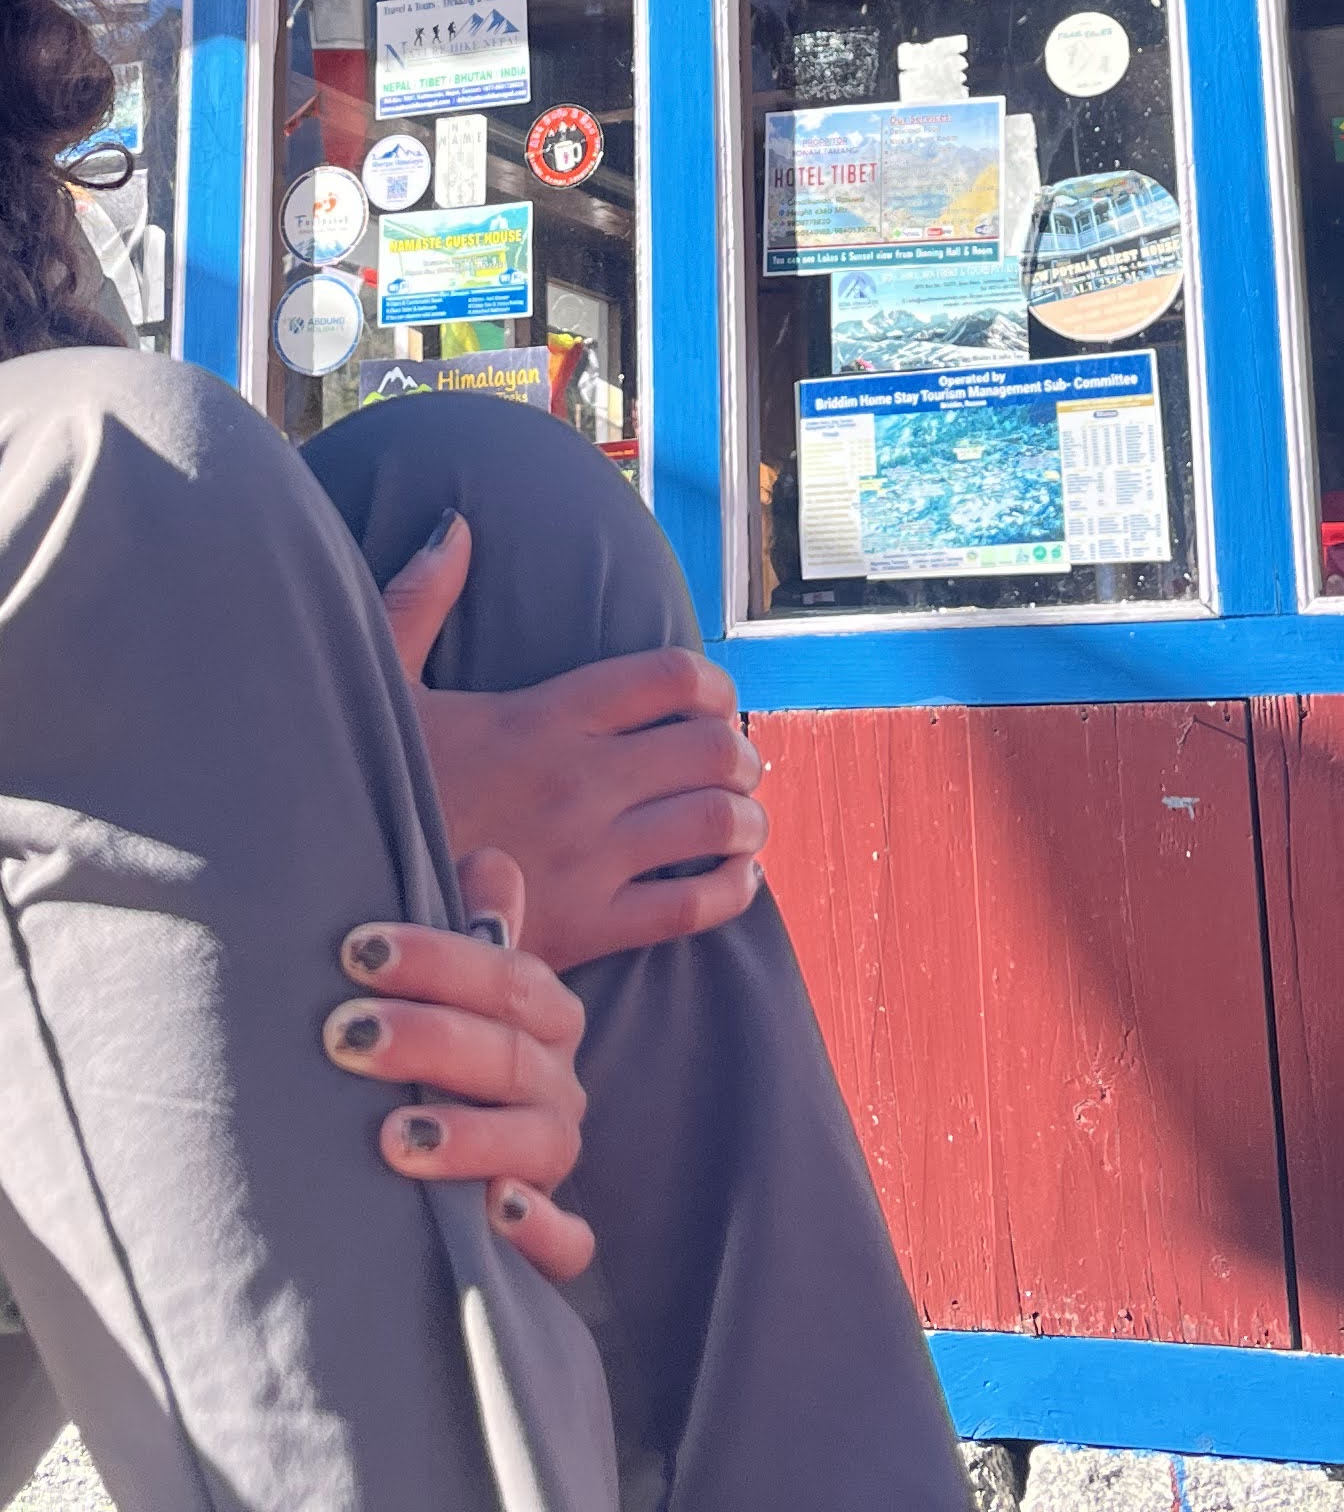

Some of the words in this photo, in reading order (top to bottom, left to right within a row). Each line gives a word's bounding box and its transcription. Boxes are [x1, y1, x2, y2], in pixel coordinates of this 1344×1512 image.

[384, 5, 405, 15] Travel
[415, 2, 435, 11] Tours
[384, 82, 411, 92] NEPAL
[419, 76, 446, 87] TIBET
[454, 71, 492, 83] BHUTAN
[501, 66, 526, 78] INDIA
[774, 166, 824, 188] HOTEL
[832, 163, 877, 184] TIBET
[389, 236, 442, 253] NAMASTE
[445, 234, 480, 247] GUEST
[485, 230, 522, 244] HOUSE
[1052, 260, 1098, 280] POTALA
[1099, 249, 1138, 269] GUEST
[438, 365, 540, 392] Himalayan
[939, 374, 989, 387] Operated
[992, 371, 1006, 384] by
[815, 397, 857, 411] Briddim
[860, 395, 892, 406] Home
[894, 391, 920, 406] Stay
[920, 388, 966, 402] Tourism
[968, 381, 1042, 399] Management
[1044, 379, 1071, 392] Sub-
[1073, 374, 1138, 390] Committee
